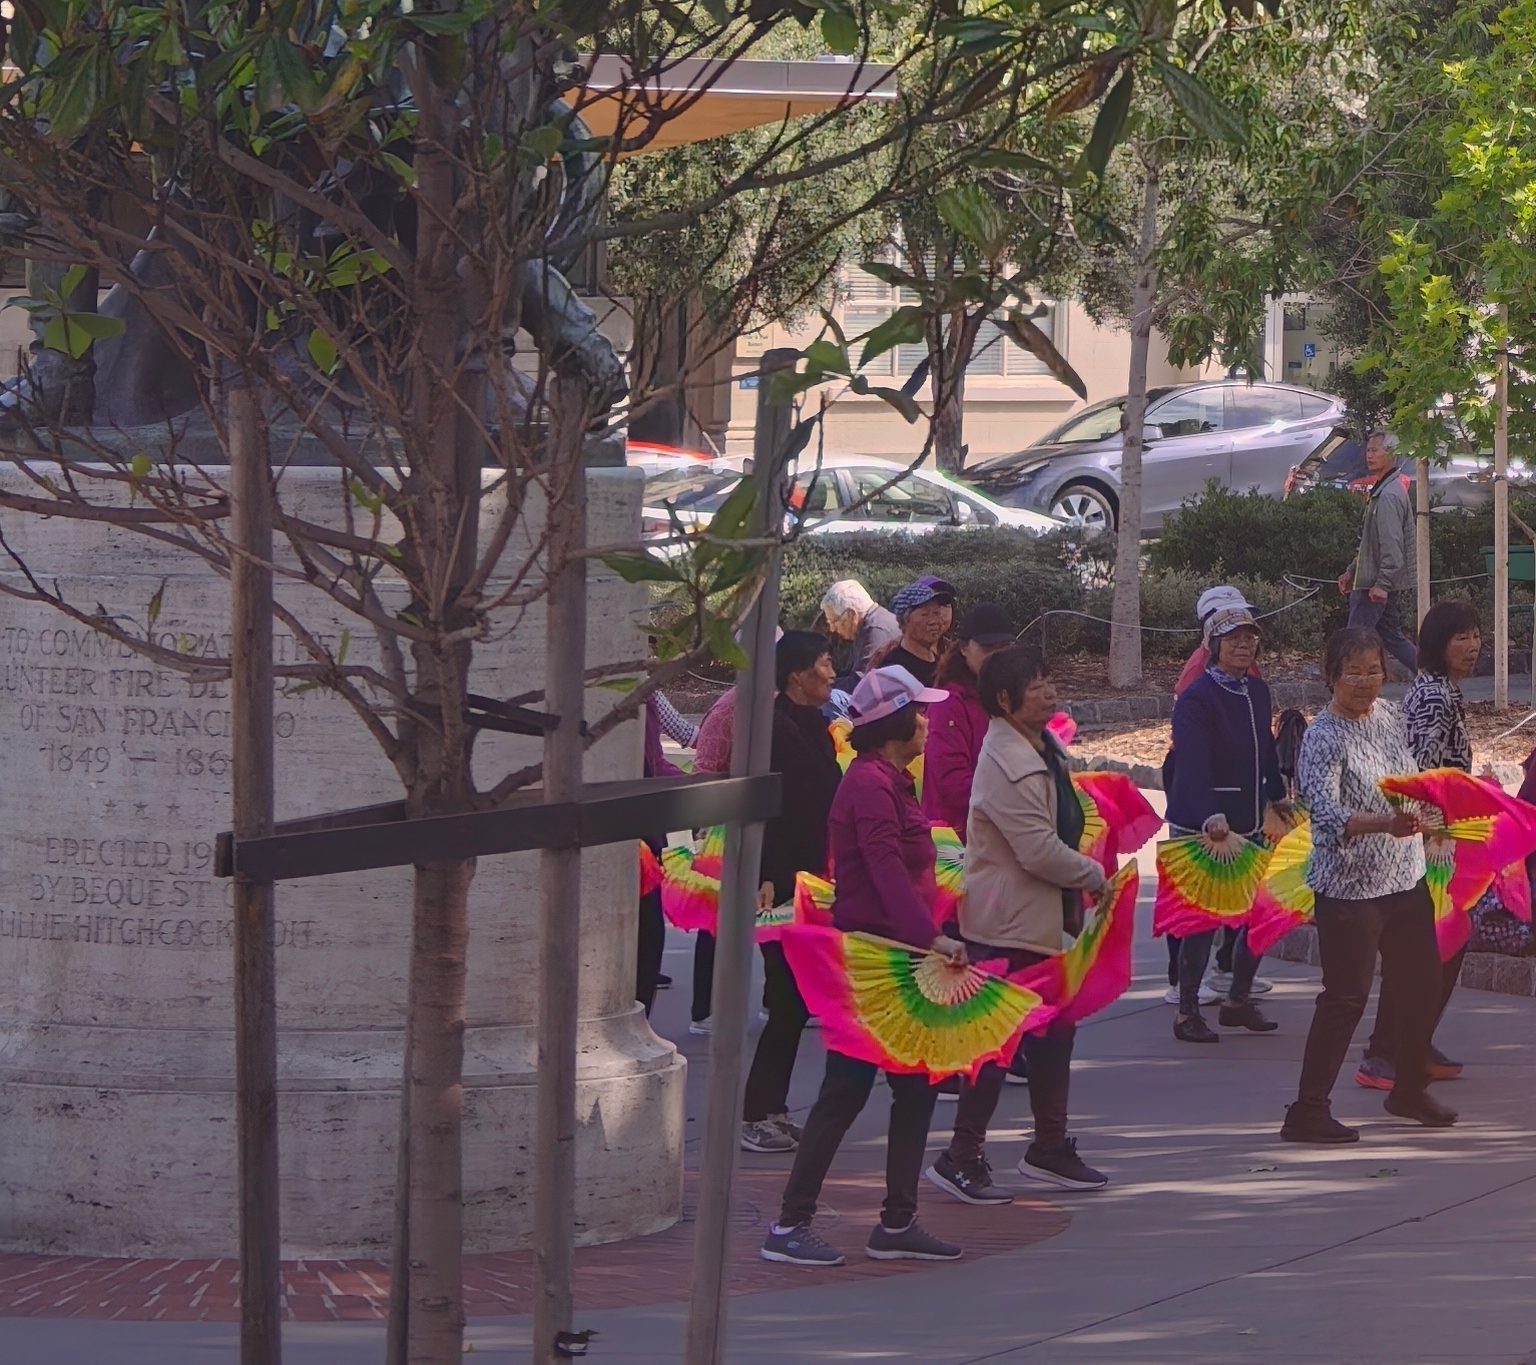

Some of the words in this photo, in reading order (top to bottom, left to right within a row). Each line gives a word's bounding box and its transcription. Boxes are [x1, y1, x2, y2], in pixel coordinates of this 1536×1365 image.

[5, 627, 29, 655] TO
[109, 668, 174, 699] FIRE
[20, 705, 47, 733] OF
[55, 707, 107, 736] SAN
[174, 749, 232, 777] 186
[44, 837, 172, 870] ERECTED
[30, 873, 63, 903] BY
[71, 876, 212, 909] BEQUEST
